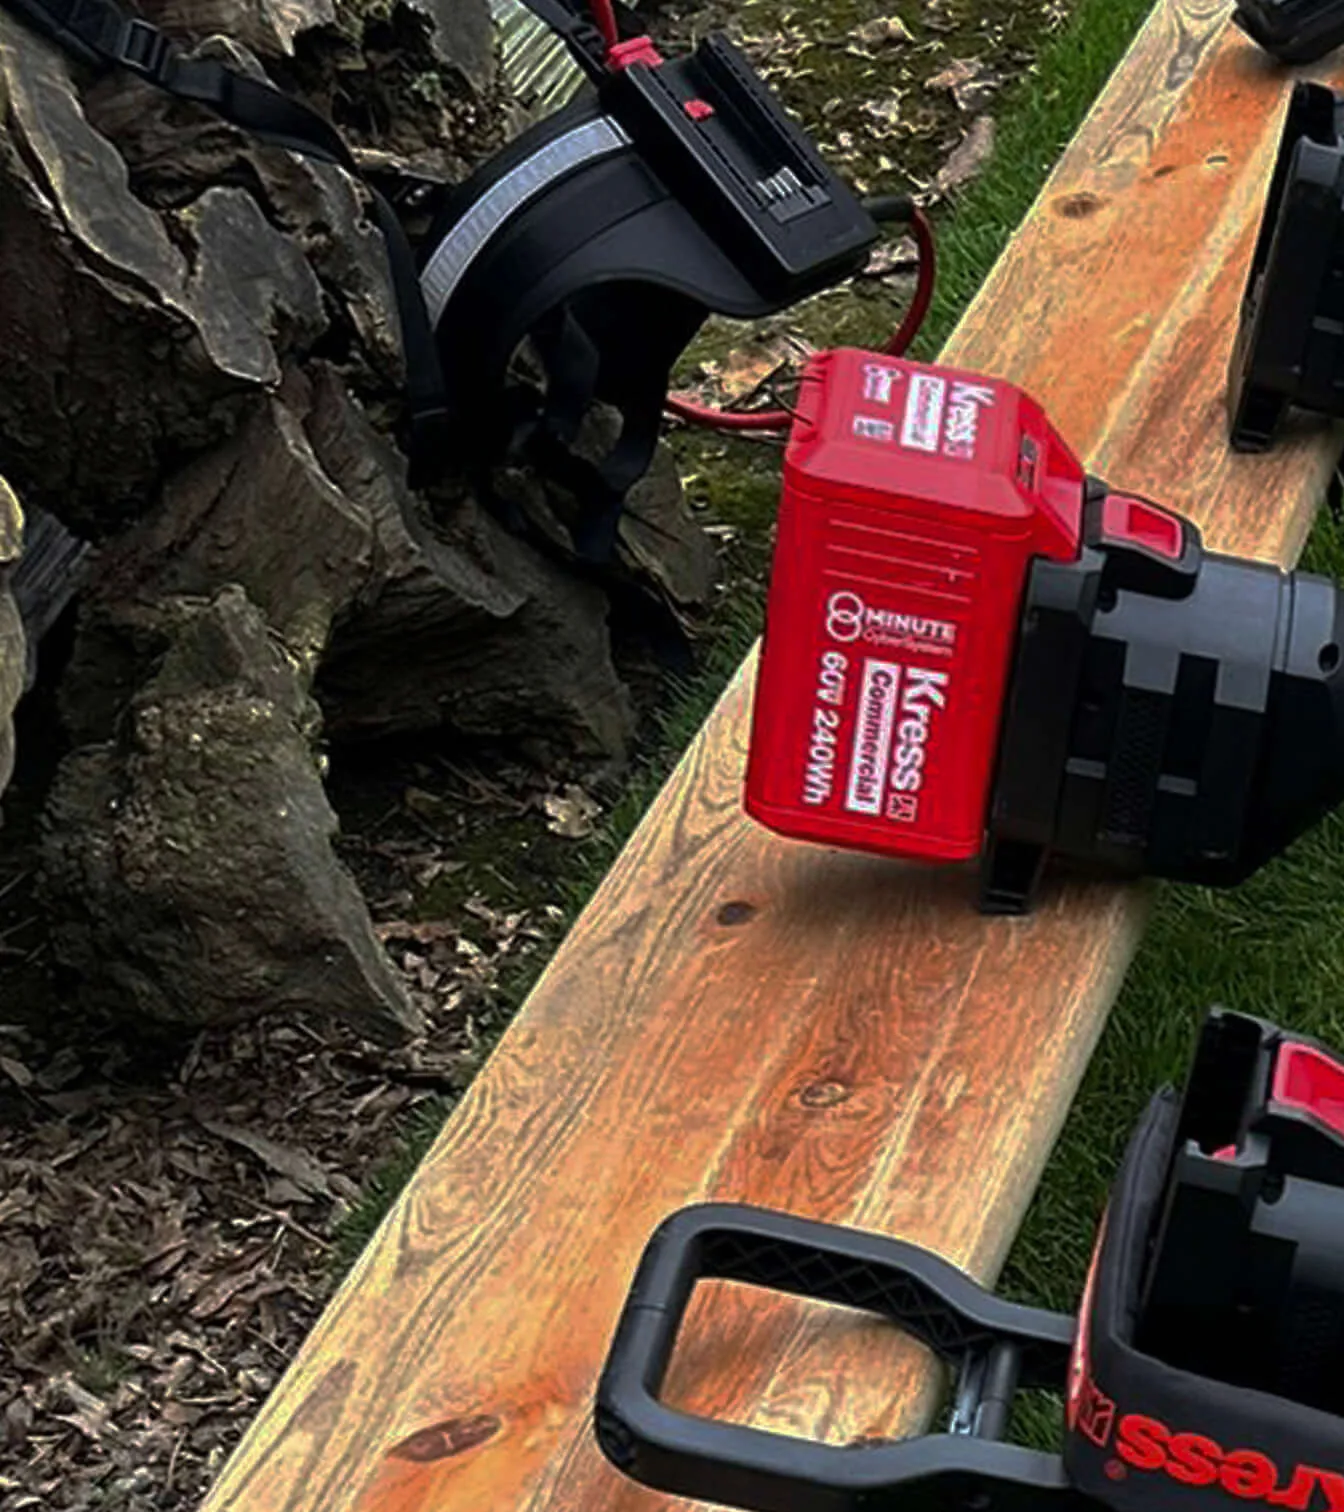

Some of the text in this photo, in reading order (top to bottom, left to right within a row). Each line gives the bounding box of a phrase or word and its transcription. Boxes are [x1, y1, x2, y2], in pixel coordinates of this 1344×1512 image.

[864, 607, 956, 643] MINUTE
[802, 650, 848, 805] 60V 240Wh
[854, 668, 894, 806] Commercial
[891, 665, 949, 792] Kress
